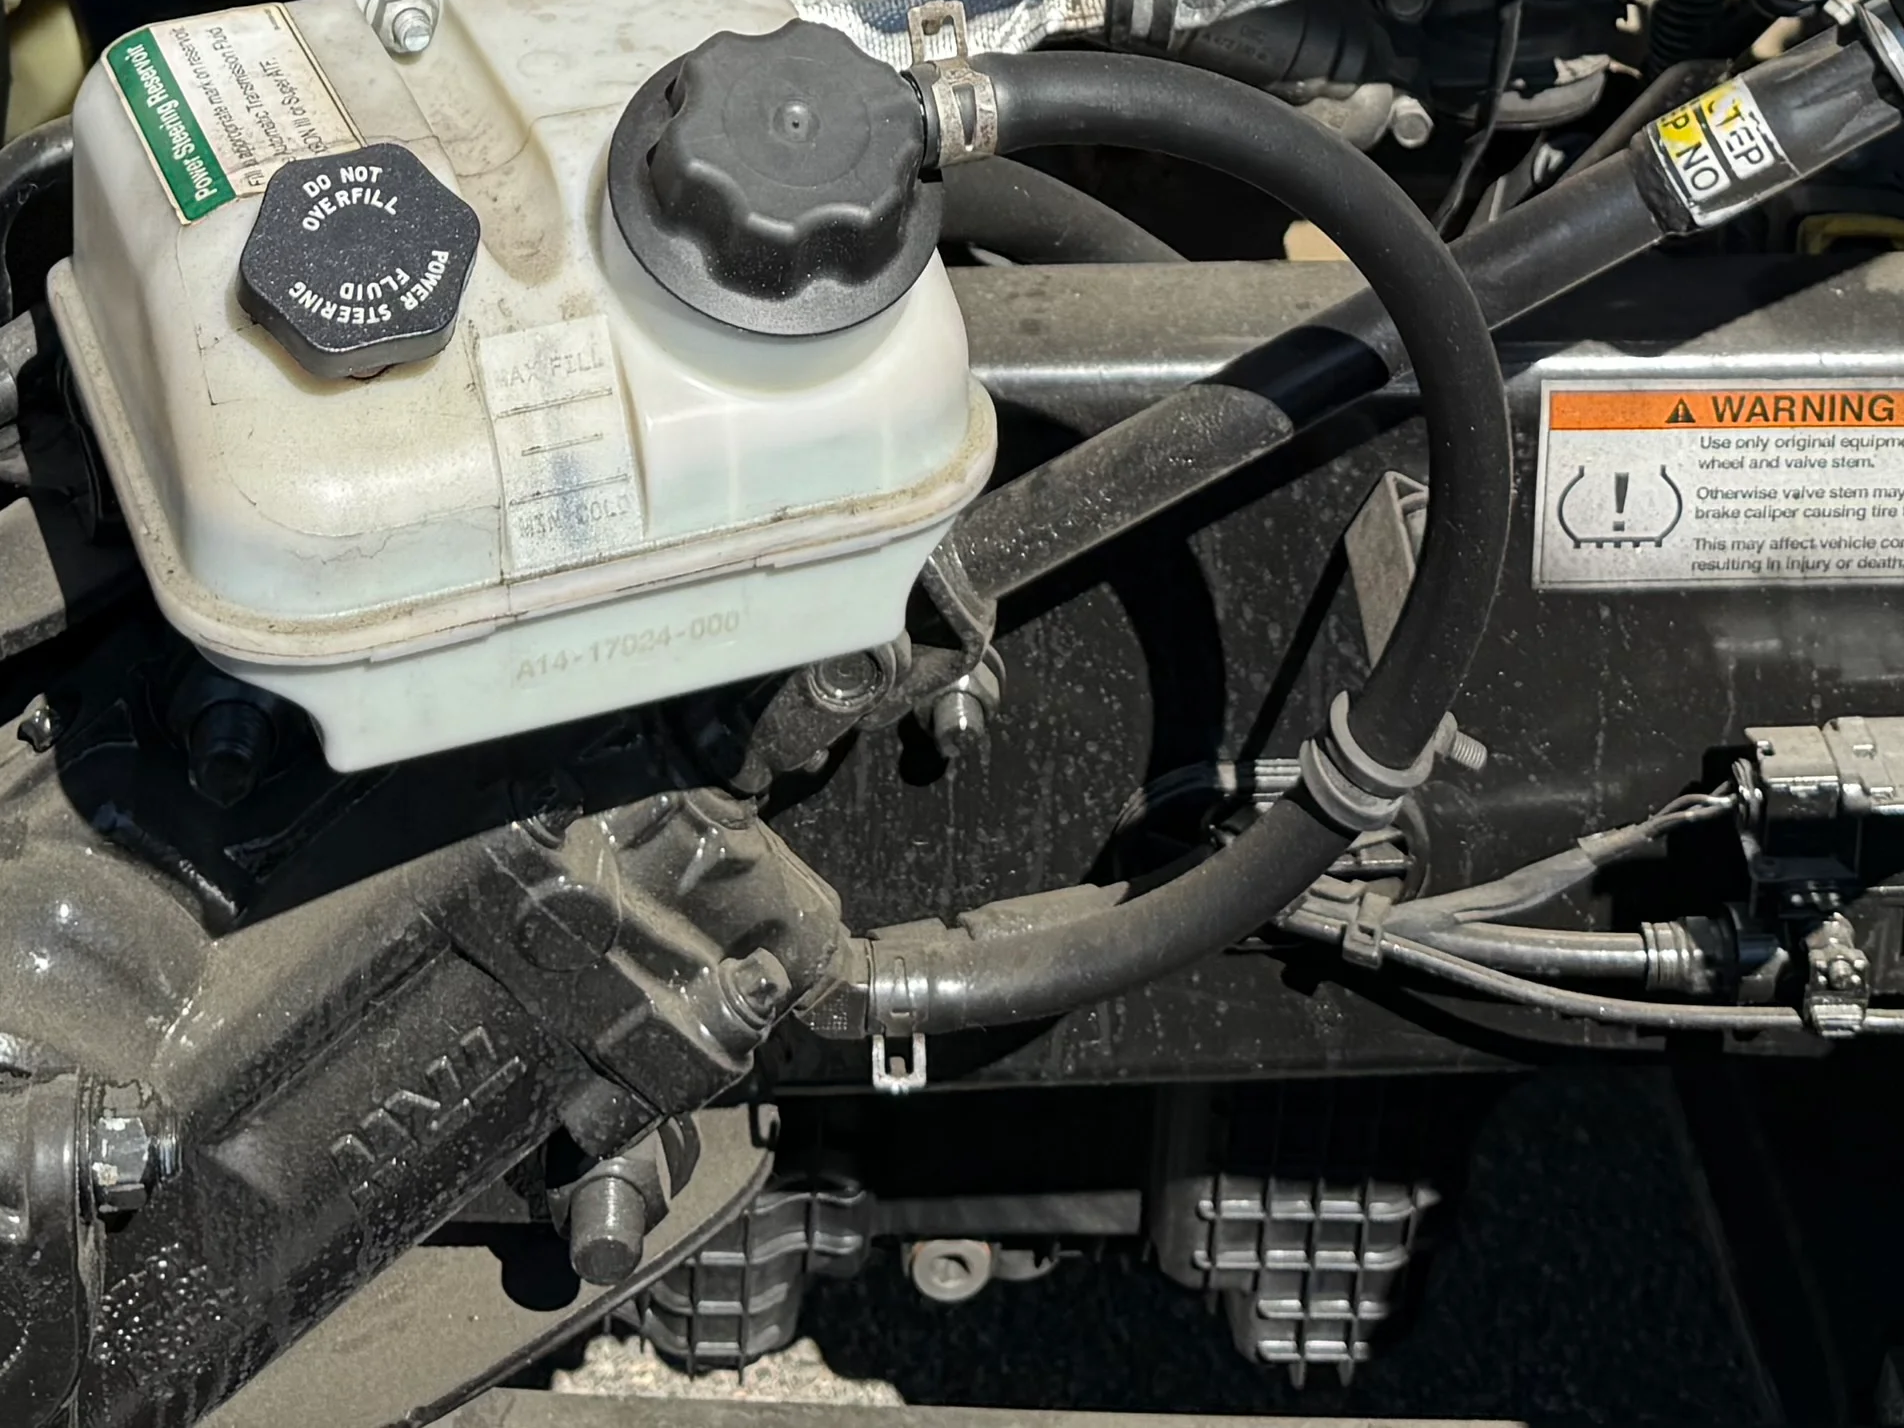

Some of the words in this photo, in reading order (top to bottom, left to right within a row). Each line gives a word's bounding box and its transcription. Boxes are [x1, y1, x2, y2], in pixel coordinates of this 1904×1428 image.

[207, 26, 229, 51] Fluid
[125, 44, 168, 107] Reservoir
[221, 48, 262, 113] Transmission
[157, 99, 195, 161] Steering
[184, 155, 217, 201] Power
[302, 173, 332, 199] DO
[341, 165, 383, 184] NOT
[1676, 141, 1719, 192] NO
[302, 186, 400, 232] OVERFILL
[339, 268, 410, 300] FLUID
[404, 249, 450, 312] POWER
[288, 281, 392, 325] STEERING
[550, 349, 606, 377] FILL
[1712, 394, 1897, 424] WARNING
[1700, 434, 1732, 450] Use
[1735, 434, 1771, 452] only
[1774, 433, 1836, 452] original
[1698, 455, 1744, 470] wheel
[1749, 455, 1781, 470] and
[1784, 455, 1827, 470] valve
[1830, 456, 1875, 470] stem.
[1696, 486, 1778, 501] Otherwise
[1782, 486, 1825, 501] valve
[1829, 487, 1869, 501] stem
[1695, 505, 1739, 521] brake
[1744, 505, 1798, 523] caliper
[1802, 505, 1867, 522] causing
[1871, 504, 1898, 519] tire
[1695, 536, 1726, 551] This
[1730, 538, 1764, 554] may
[1768, 535, 1817, 551] affect
[1819, 535, 1876, 550] vehicle
[1691, 556, 1761, 573] resulting
[1766, 556, 1781, 571] in
[1786, 556, 1831, 574] injury
[1835, 558, 1854, 571] or
